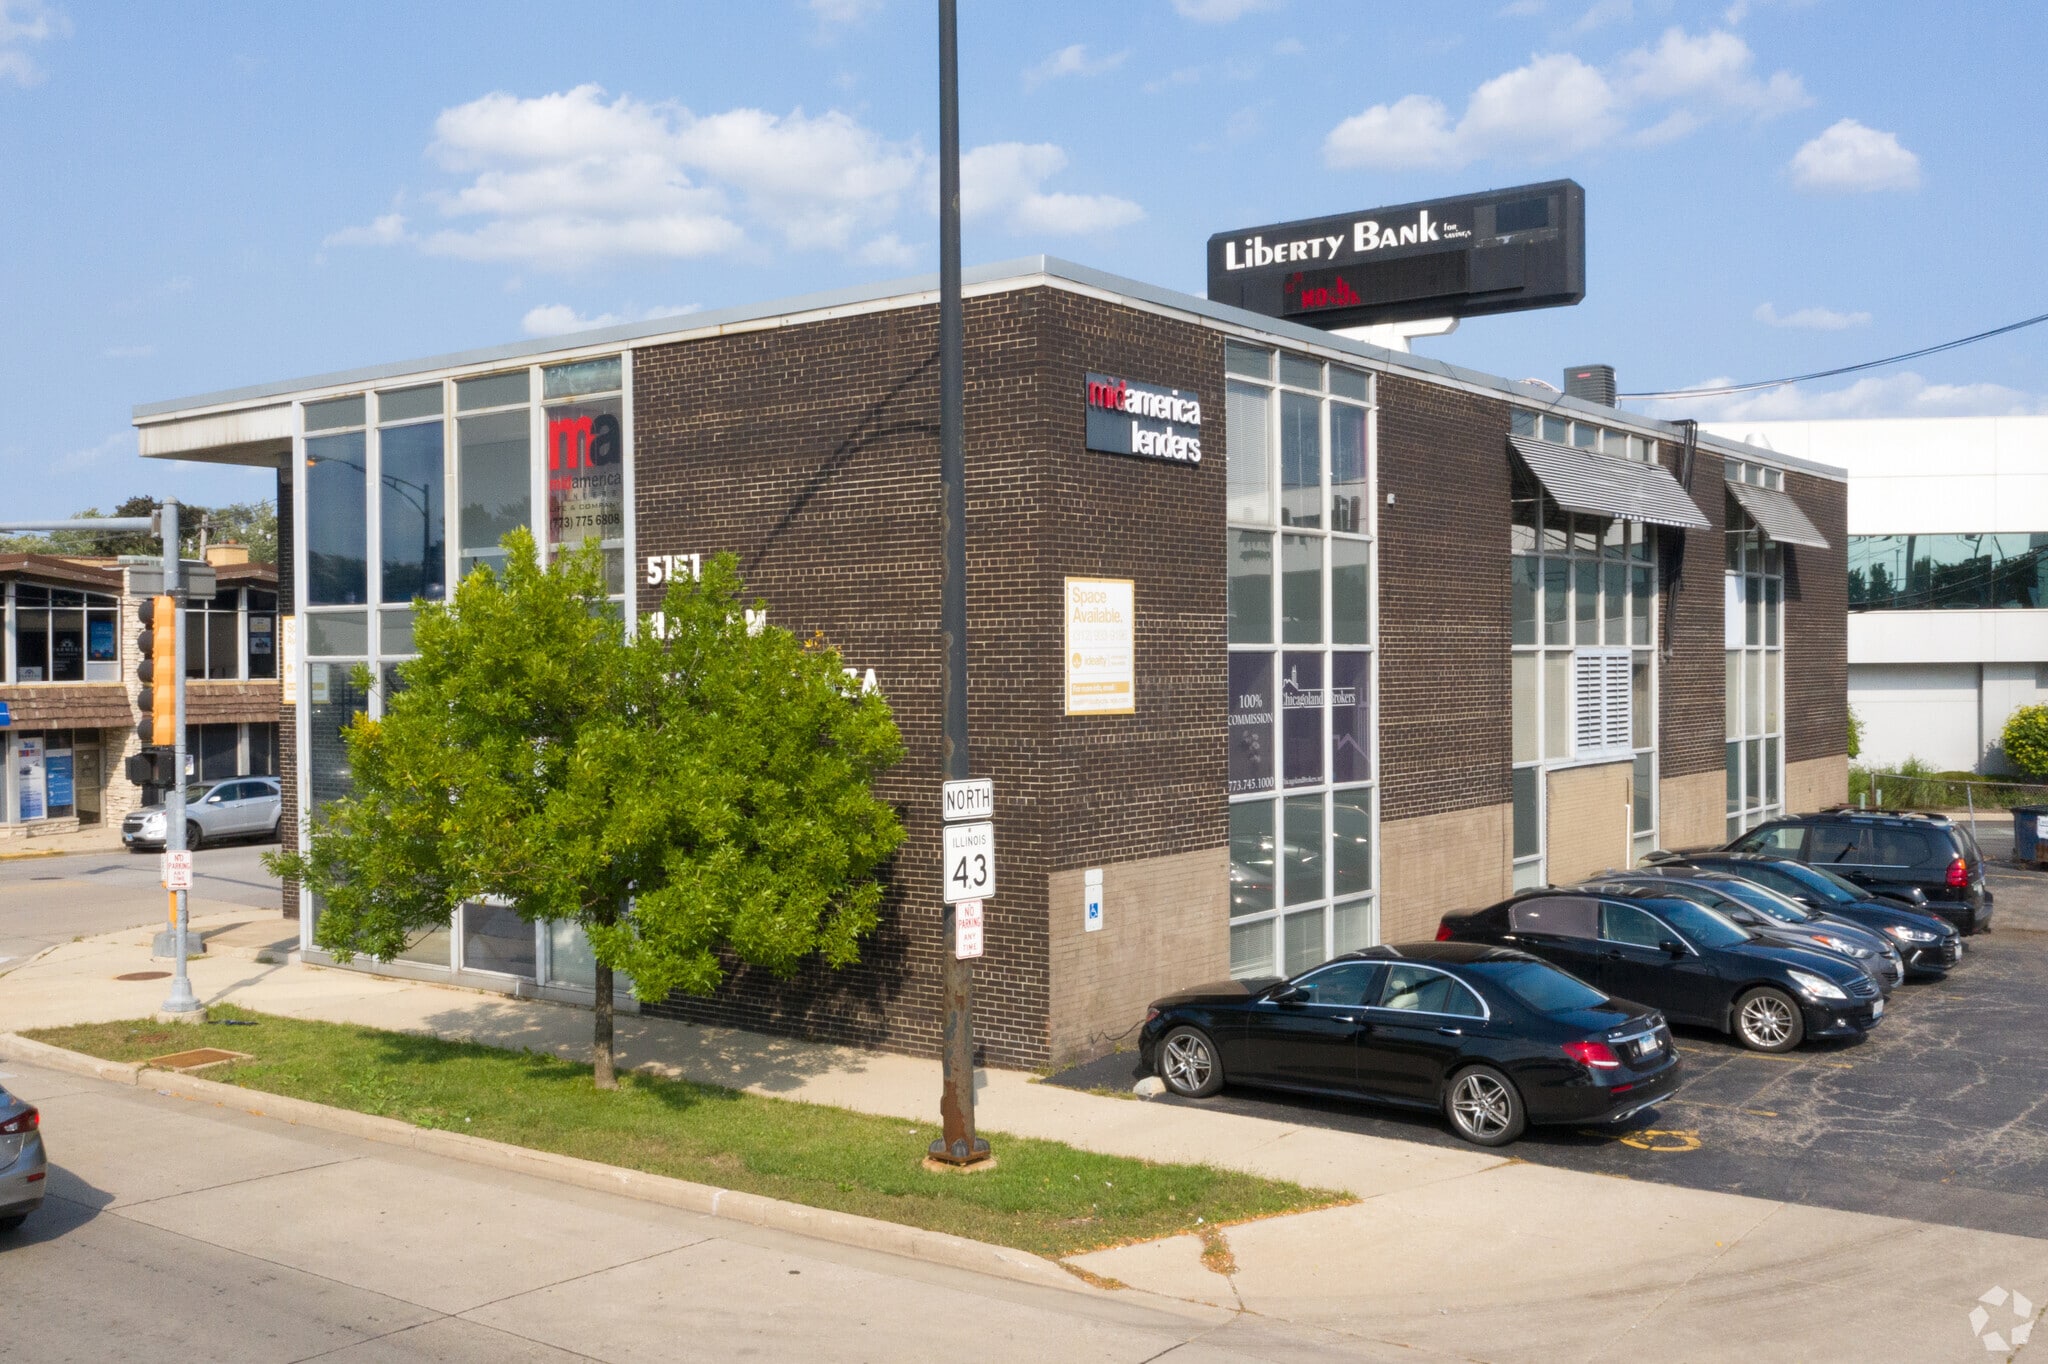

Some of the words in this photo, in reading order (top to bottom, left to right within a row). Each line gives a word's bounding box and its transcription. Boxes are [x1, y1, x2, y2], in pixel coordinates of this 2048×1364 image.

[1088, 377, 1200, 424] midamerica
[1132, 421, 1201, 462] lenders
[576, 516, 593, 527] 775
[596, 513, 620, 526] 6808
[1072, 586, 1107, 606] Space
[1239, 694, 1263, 709] 100%
[1331, 690, 1356, 704] rokers
[1228, 713, 1273, 726] COMMISSION
[947, 788, 990, 811] NORTH
[953, 834, 987, 848] ILLINOIS
[953, 854, 987, 888] 43
[964, 906, 974, 916] NO
[958, 919, 981, 929] PARKING
